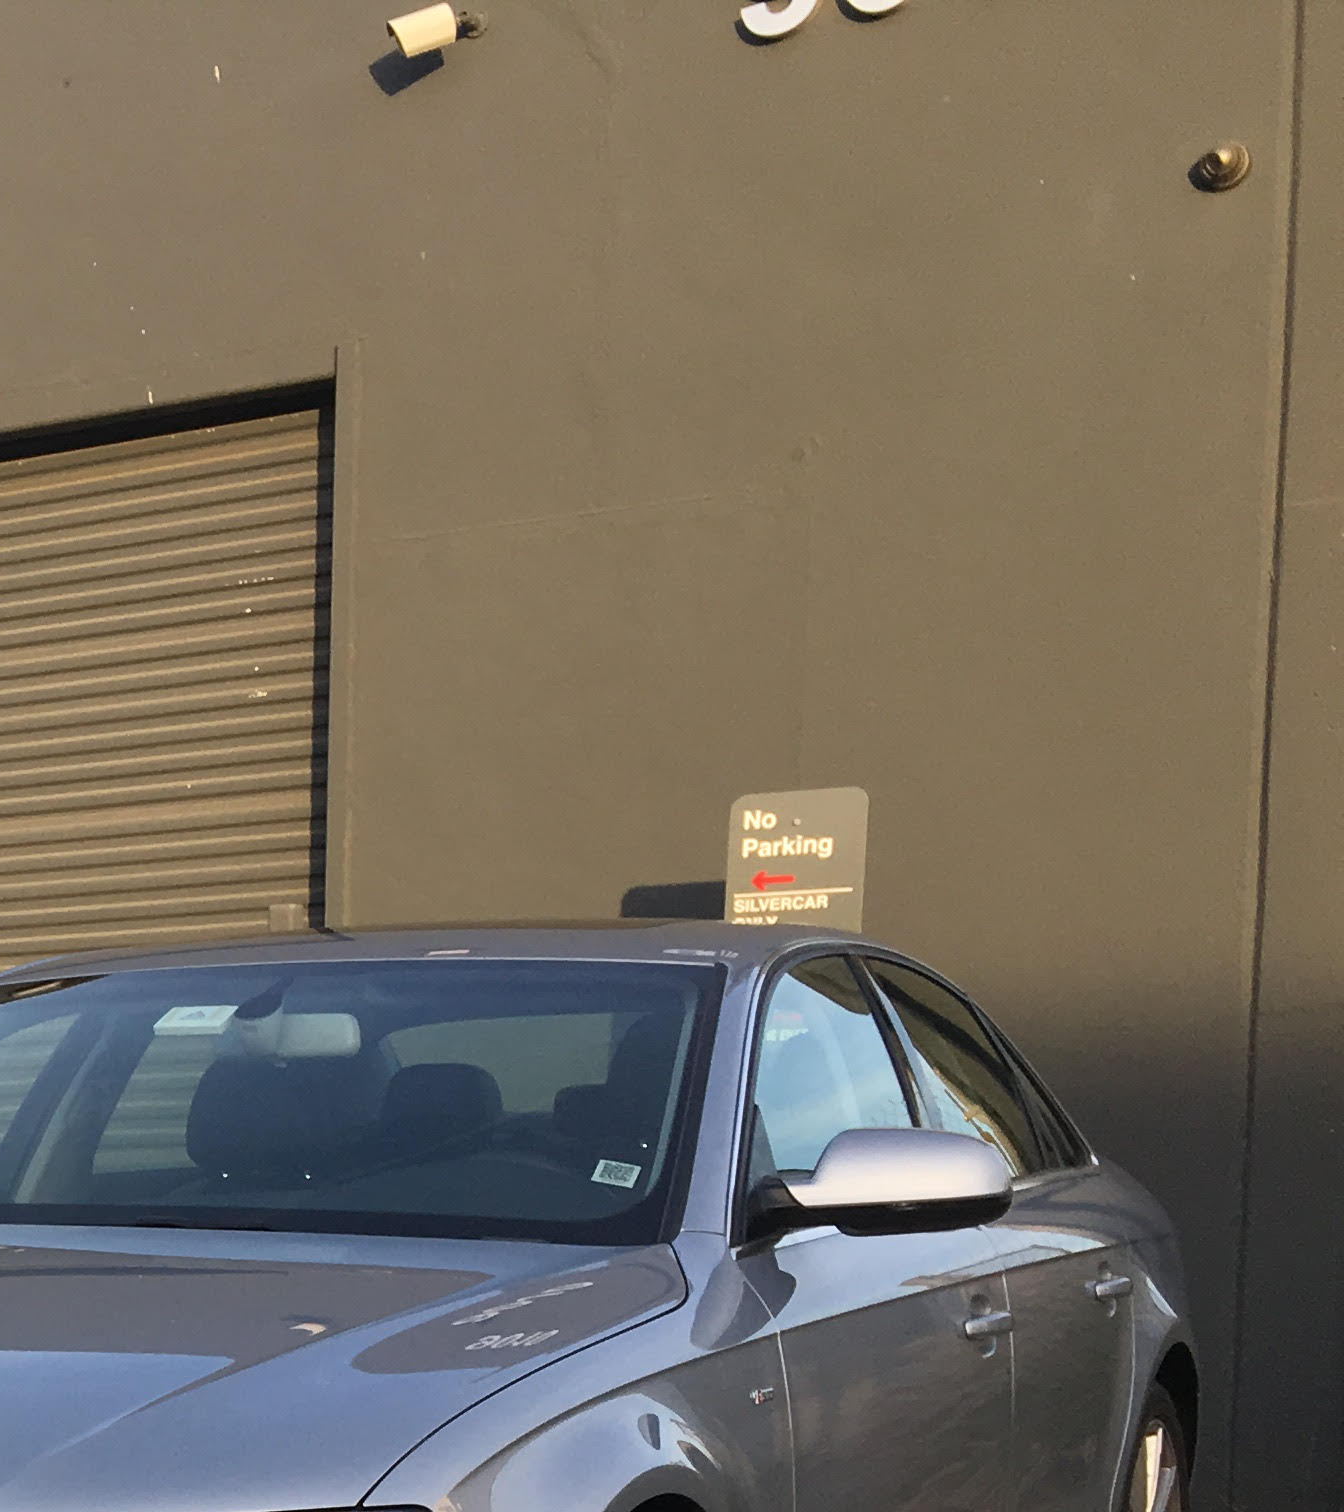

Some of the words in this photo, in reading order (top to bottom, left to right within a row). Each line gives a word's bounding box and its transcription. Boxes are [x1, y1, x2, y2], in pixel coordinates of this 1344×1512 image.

[742, 810, 777, 831] No
[741, 835, 834, 859] Parking
[733, 895, 829, 914] SILVERCAR
